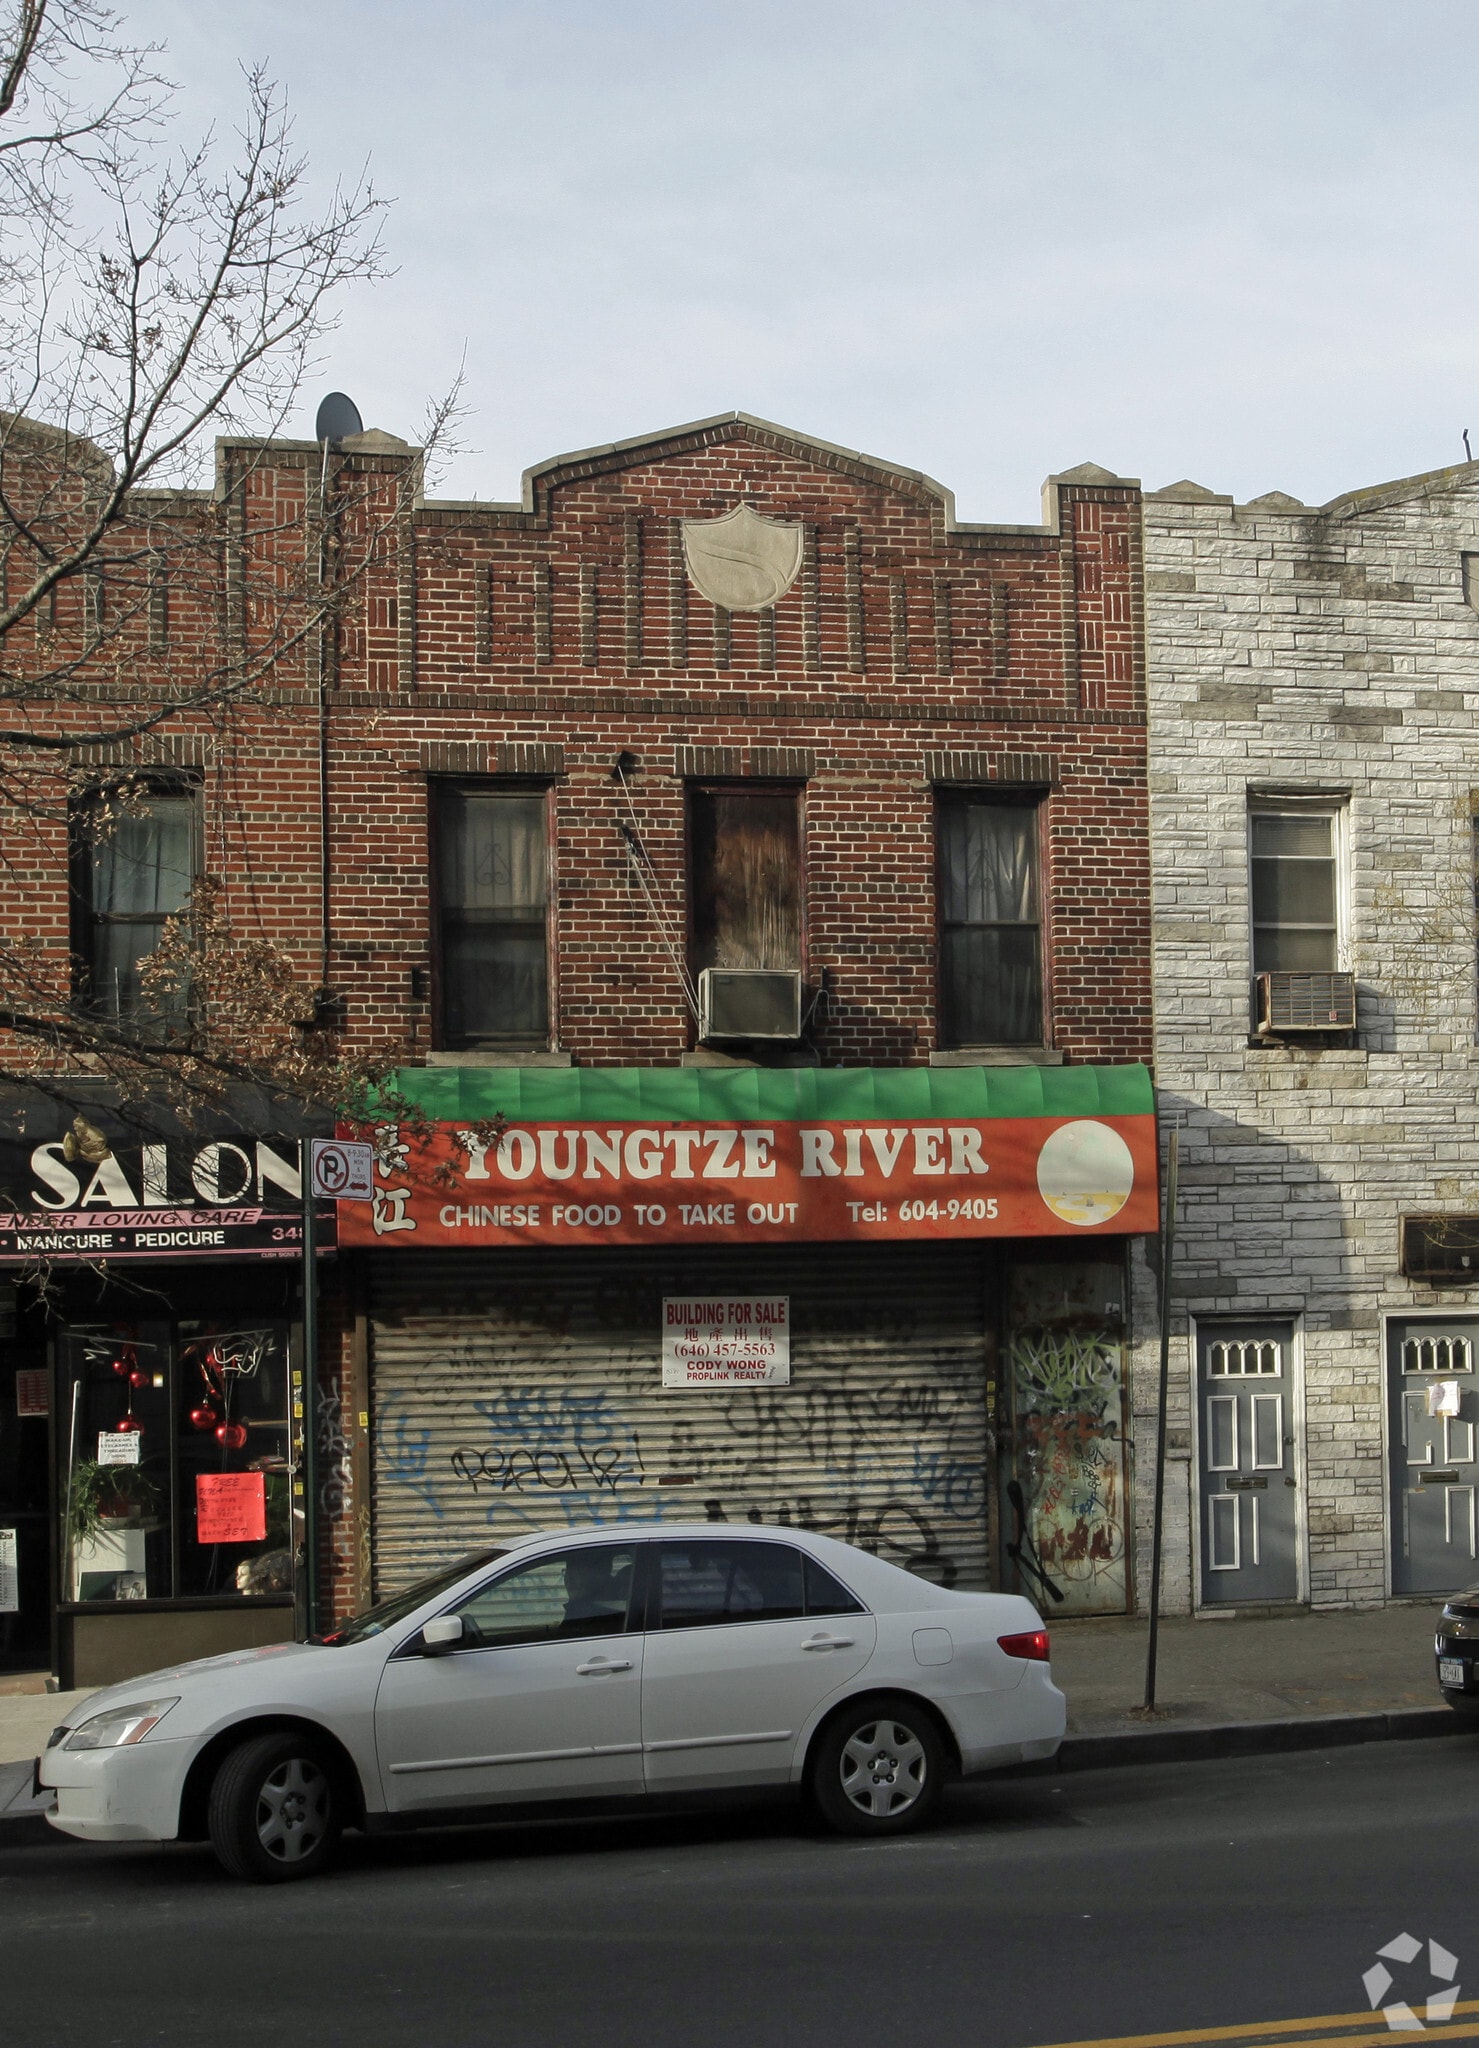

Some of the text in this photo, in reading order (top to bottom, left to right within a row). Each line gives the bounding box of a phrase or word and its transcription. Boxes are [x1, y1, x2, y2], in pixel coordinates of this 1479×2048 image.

[457, 1128, 989, 1180] YOUNGTZE RIVER
[31, 1141, 303, 1210] SALON
[88, 1211, 181, 1226] LOVING
[191, 1210, 260, 1225] CARE
[440, 1202, 798, 1227] CHINESE FOOD TO TAKE OUT
[846, 1198, 999, 1223] Tel: 604-9405
[17, 1231, 225, 1249] MANICURE PEDICURE
[667, 1302, 785, 1325] BUILDING FOR SALE
[674, 1342, 775, 1358] (646) 457-5563
[687, 1360, 766, 1370] CODY WONG
[687, 1372, 729, 1380] PROPLINK
[734, 1371, 766, 1380] REALTY
